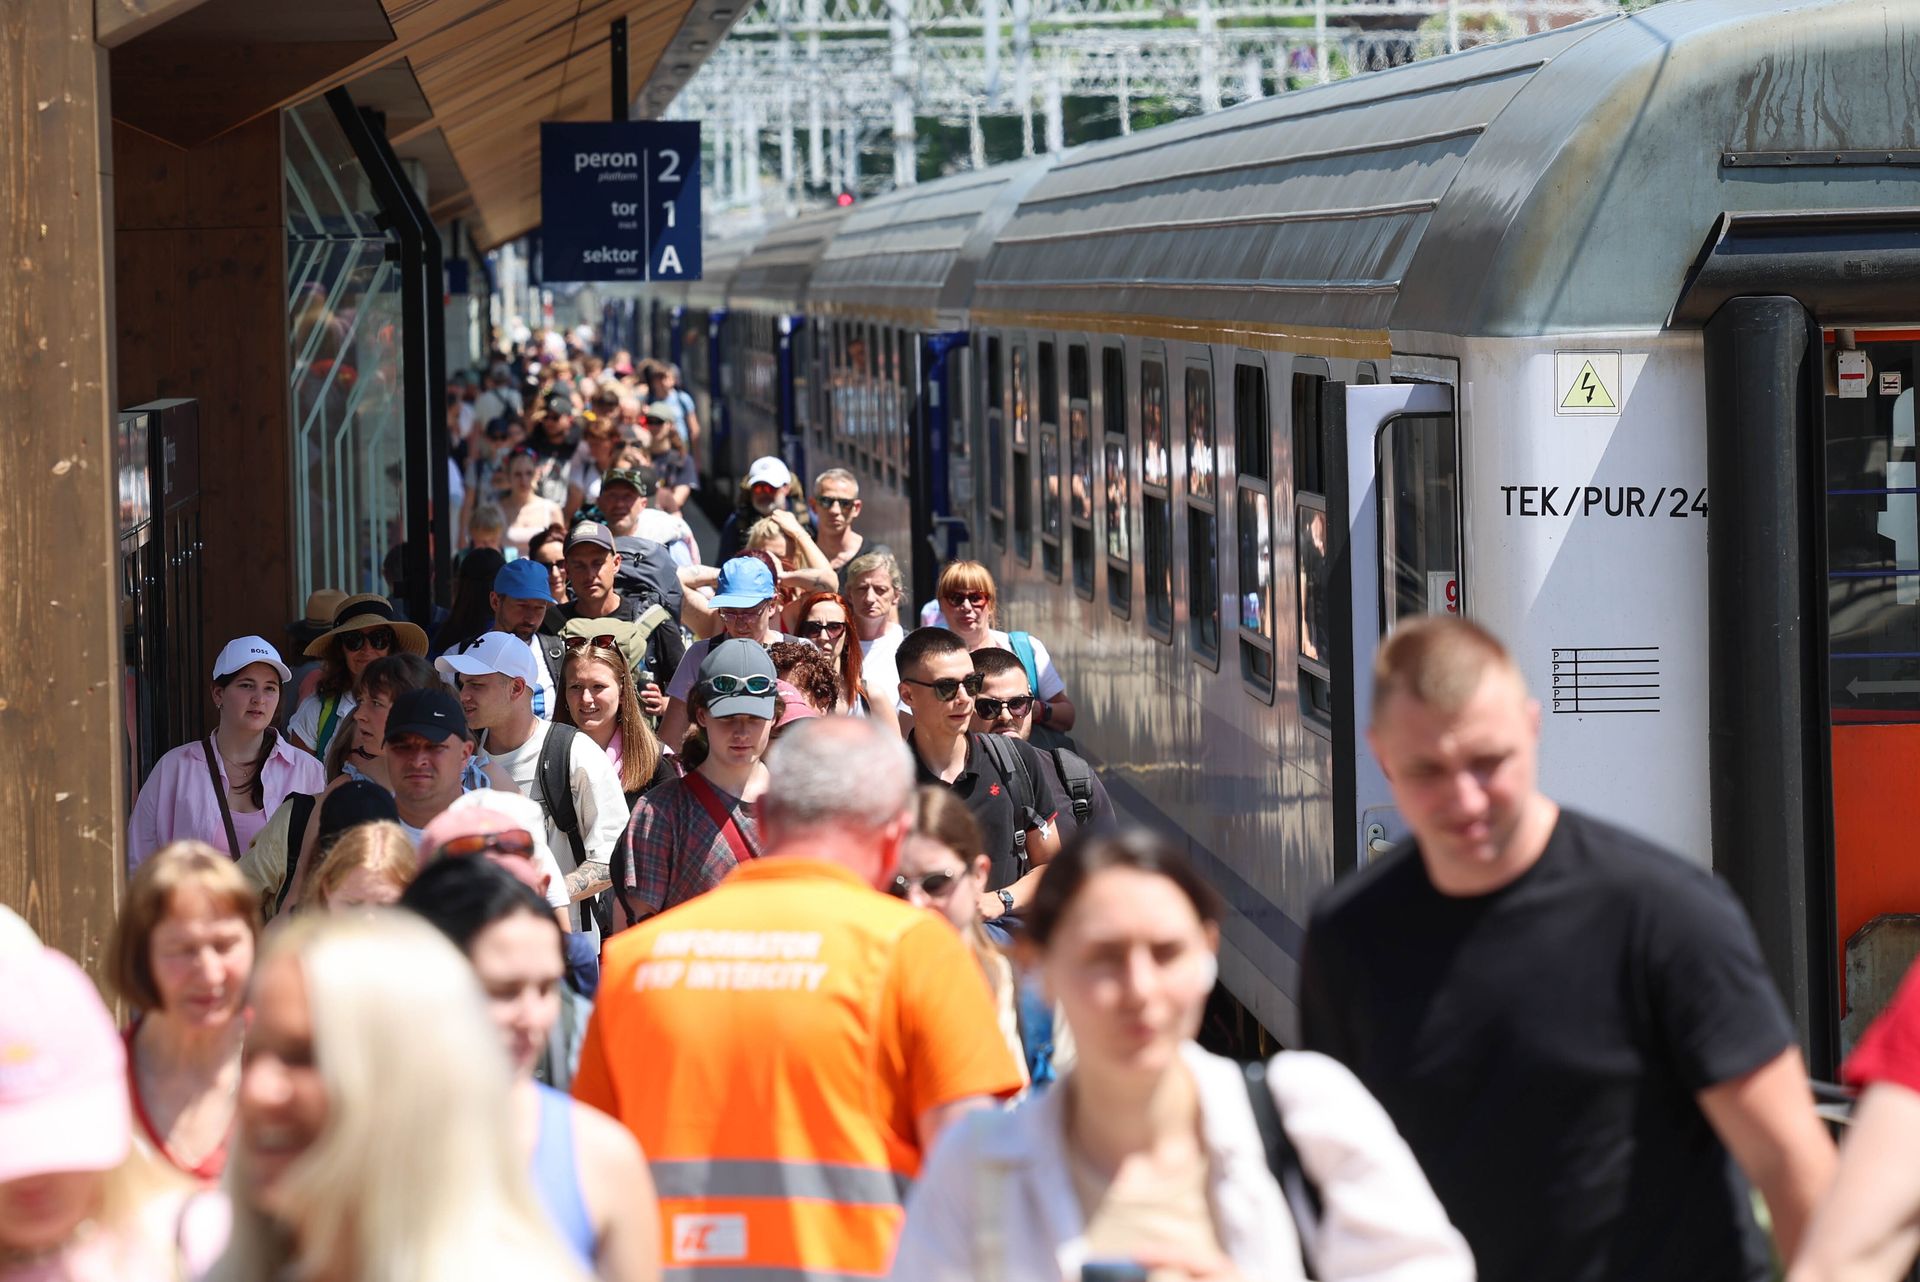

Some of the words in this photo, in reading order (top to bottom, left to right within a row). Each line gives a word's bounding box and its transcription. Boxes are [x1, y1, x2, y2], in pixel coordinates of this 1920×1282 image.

[575, 152, 637, 173] peron
[658, 149, 681, 182] 2
[598, 171, 637, 184] platform
[611, 201, 637, 217] tor
[662, 200, 676, 228] 1
[583, 246, 638, 263] sektor
[658, 245, 683, 274] A
[1500, 486, 1708, 518] TEK/PUR/24
[1553, 651, 1560, 660] P
[1553, 664, 1560, 673] P
[1553, 676, 1560, 685] P
[1554, 689, 1560, 698] P
[1554, 701, 1560, 710] P
